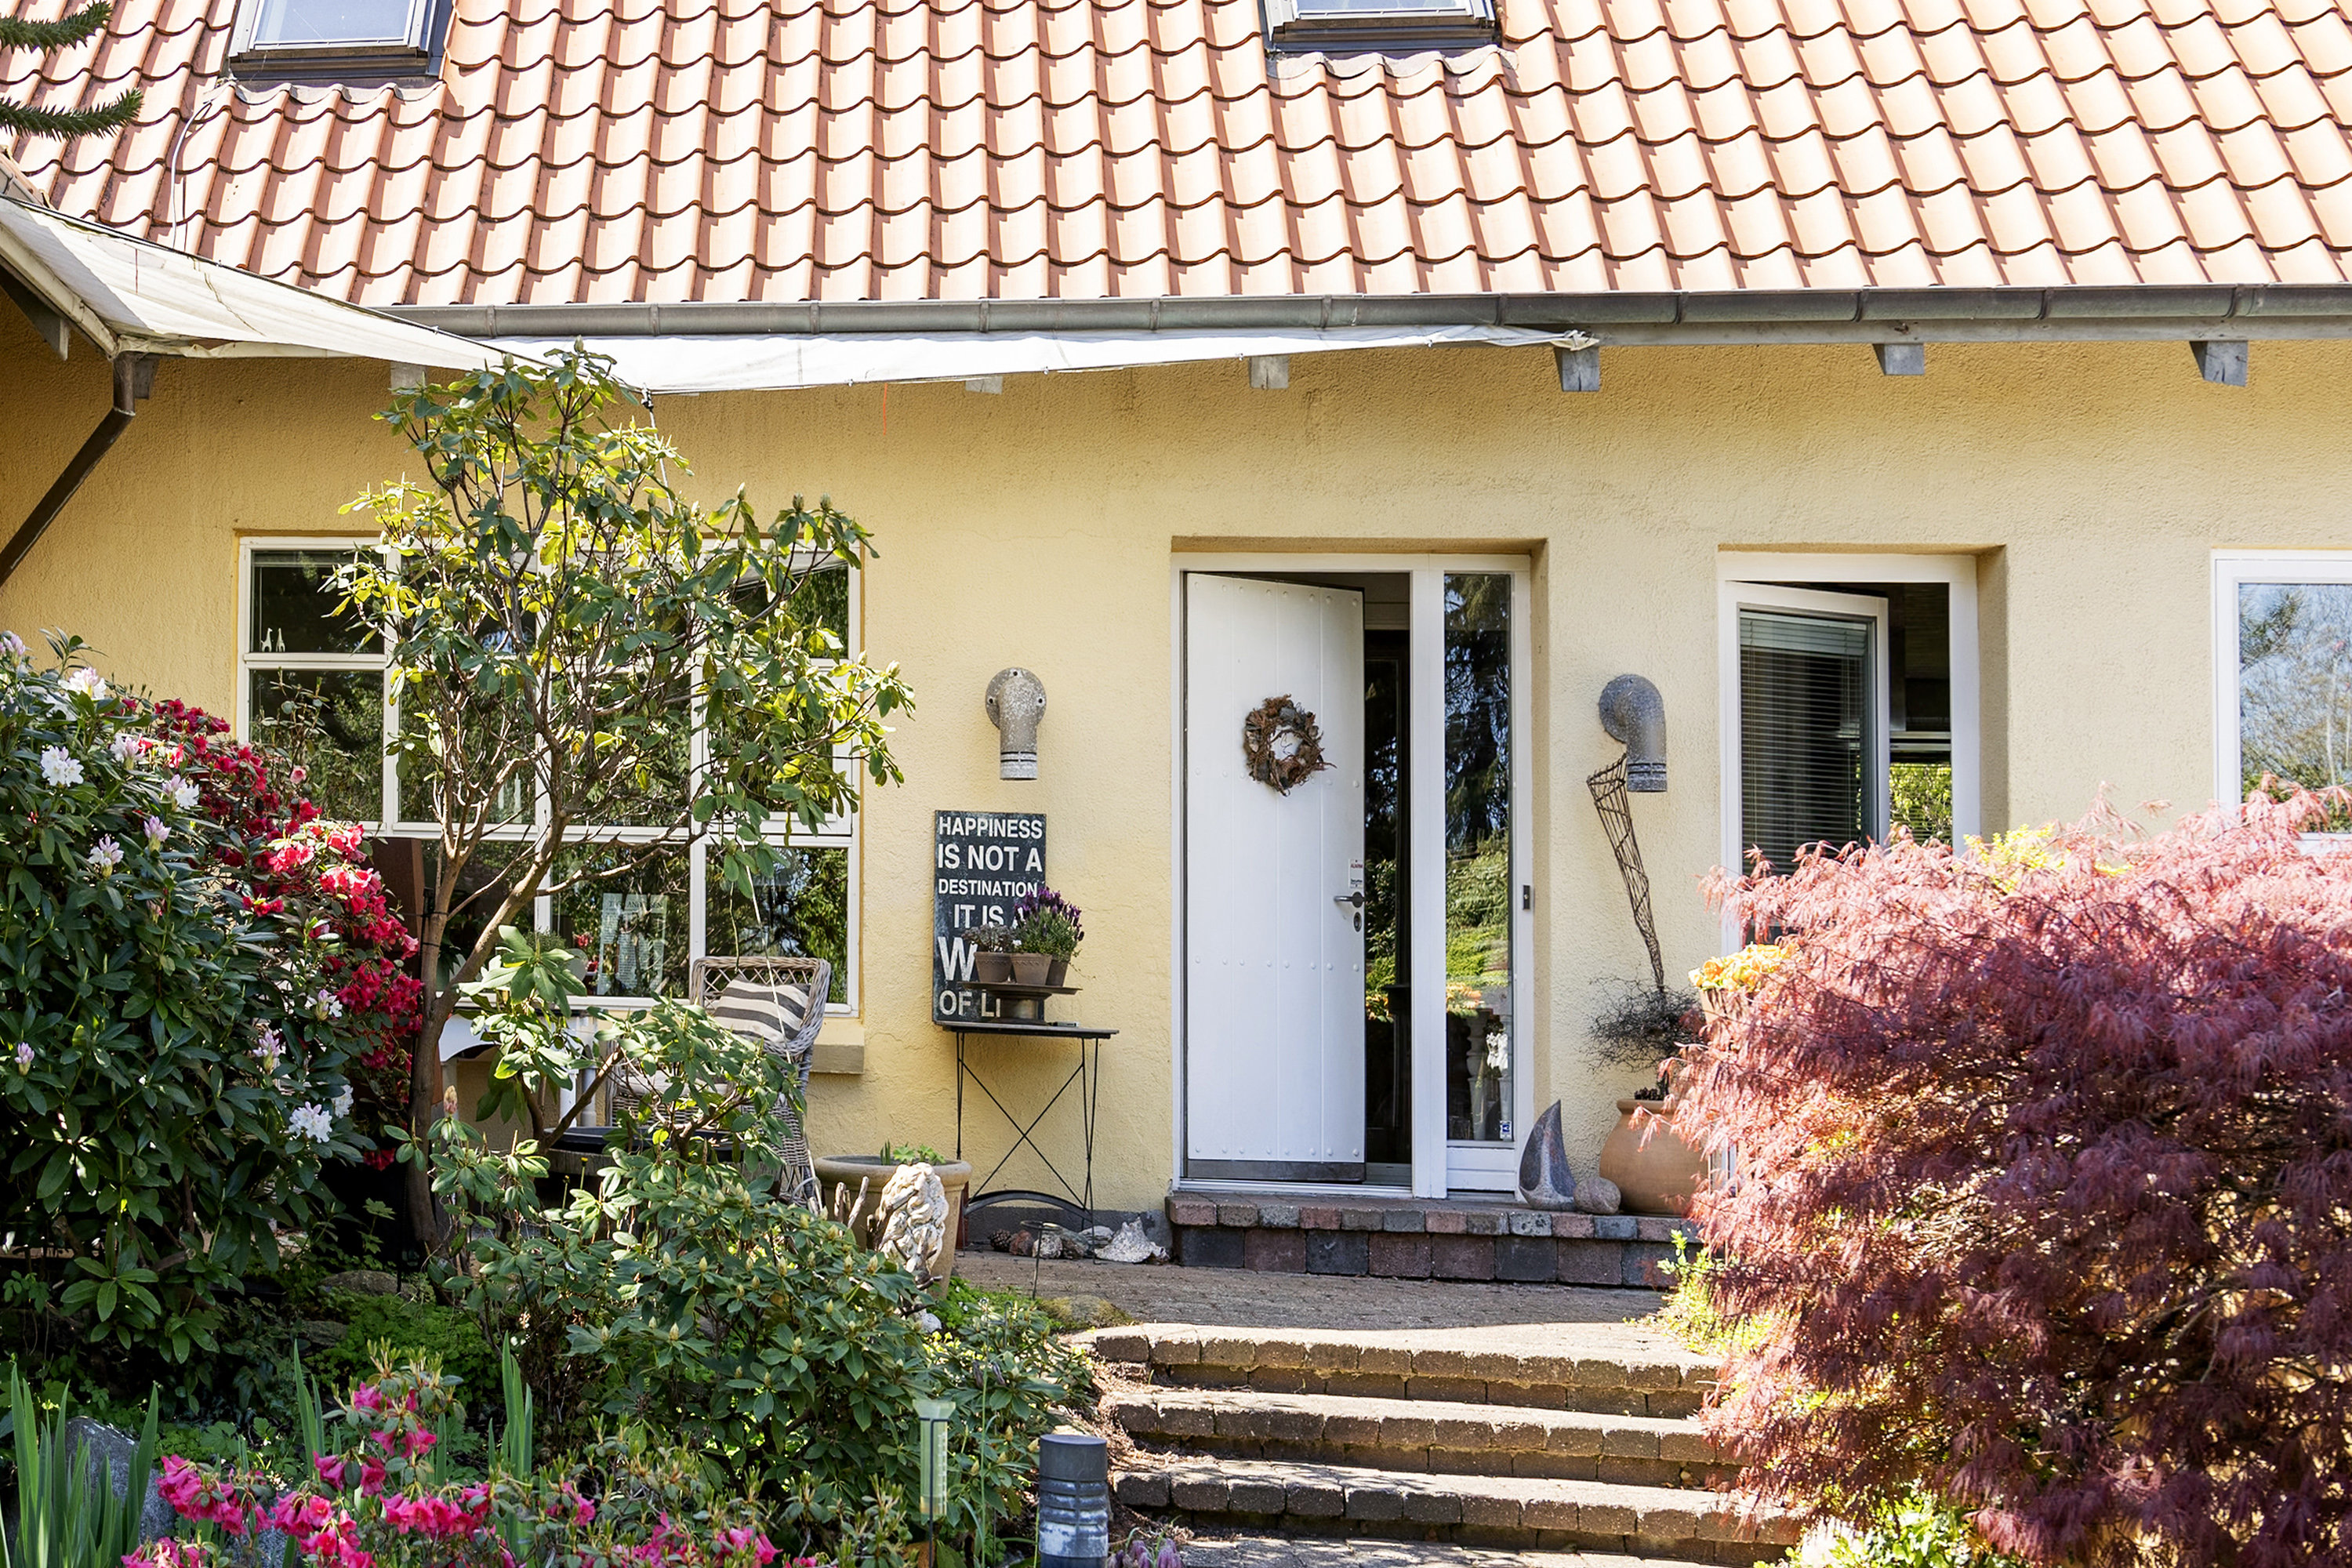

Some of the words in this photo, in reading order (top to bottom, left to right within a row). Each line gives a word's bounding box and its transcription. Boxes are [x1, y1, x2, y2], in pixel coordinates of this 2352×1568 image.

[939, 816, 1043, 840] HAPPINESS
[938, 843, 960, 869] IS
[967, 844, 1019, 872] NOT
[1025, 847, 1043, 873] A
[938, 878, 1038, 898] DESTINATION
[954, 904, 975, 929] IT
[982, 905, 1004, 928] IS
[939, 989, 973, 1016] OF
[981, 989, 1001, 1018] LI
